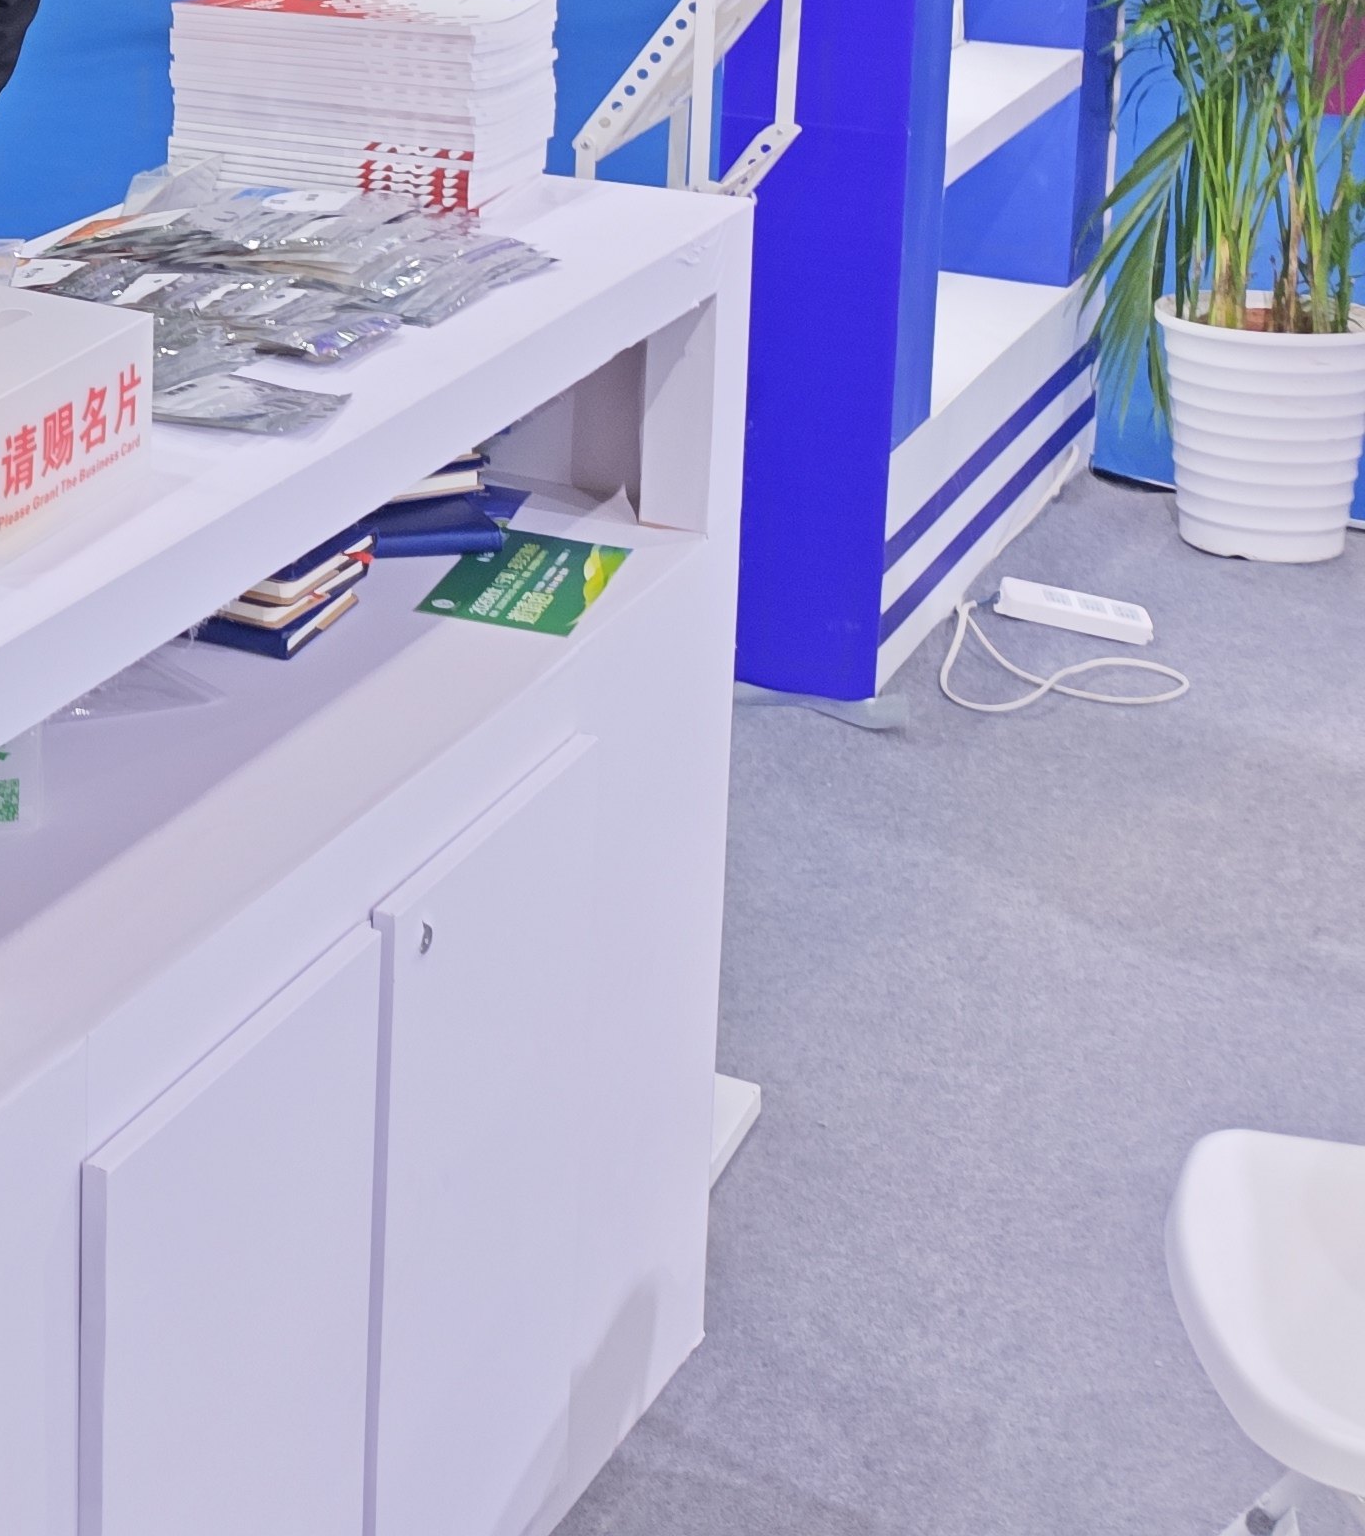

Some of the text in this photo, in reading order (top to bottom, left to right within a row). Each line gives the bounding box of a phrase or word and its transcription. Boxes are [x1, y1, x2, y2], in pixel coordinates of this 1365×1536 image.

[1, 363, 142, 499] 请赐名片
[33, 485, 59, 511] Grant
[60, 475, 78, 494] The
[79, 449, 120, 483] Business
